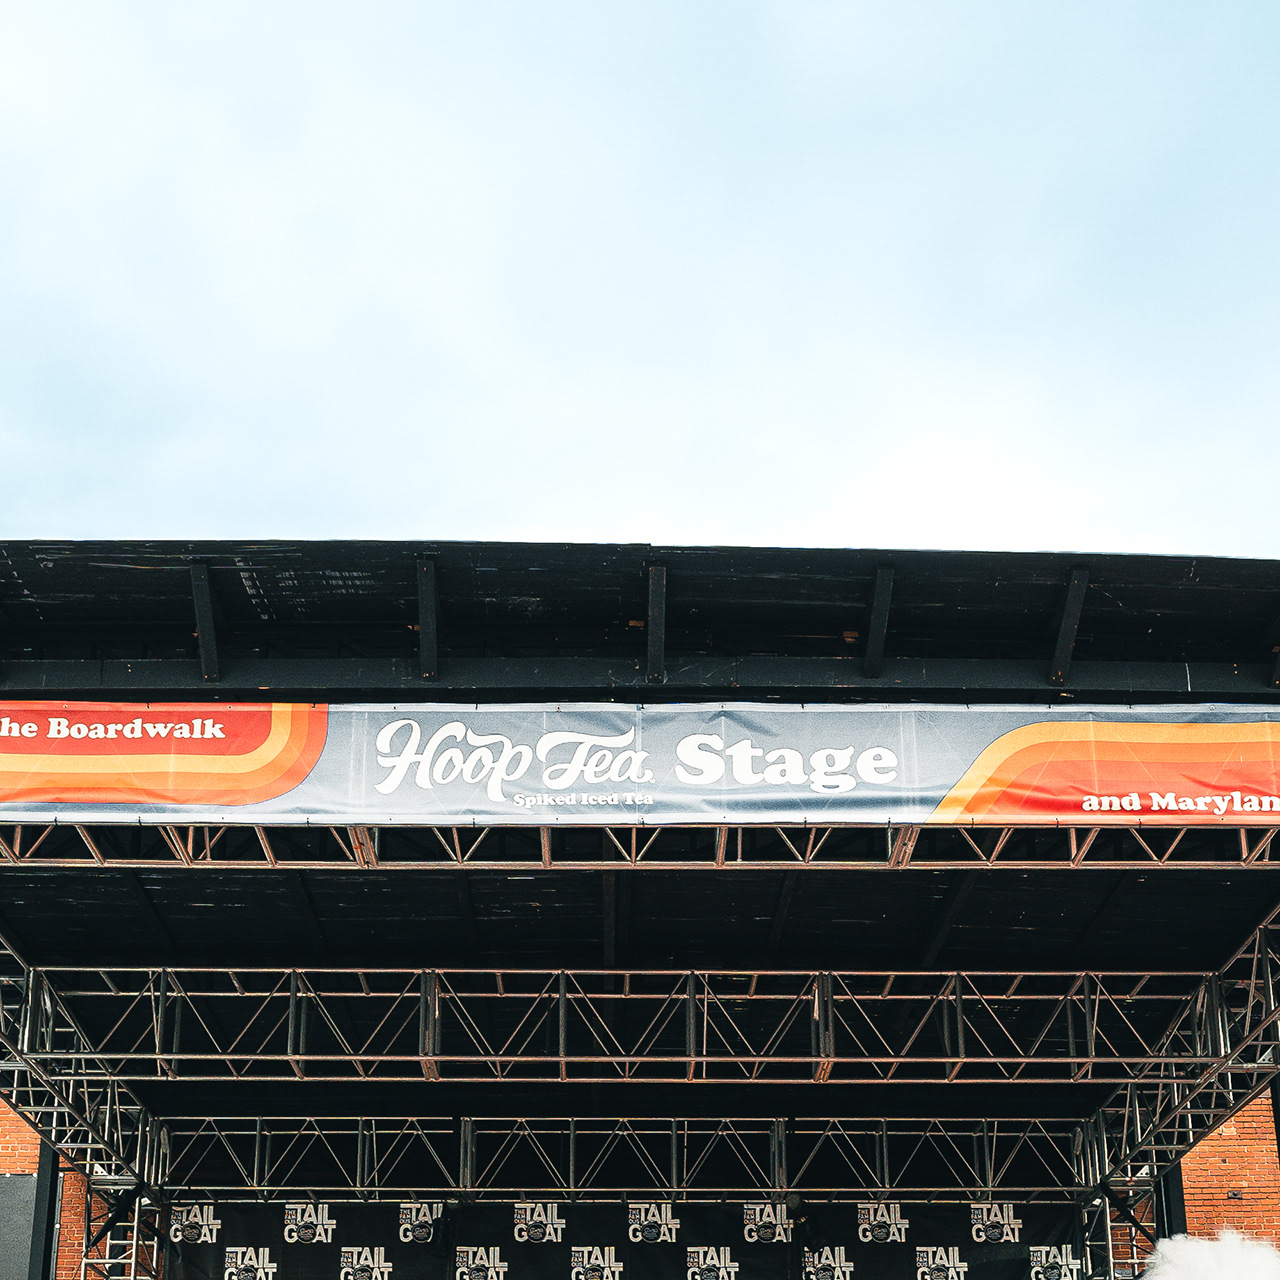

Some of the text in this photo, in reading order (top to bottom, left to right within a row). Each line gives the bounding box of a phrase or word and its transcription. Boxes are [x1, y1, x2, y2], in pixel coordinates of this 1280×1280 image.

[46, 718, 226, 740] Boardwalk
[374, 718, 533, 802] Hoop
[675, 733, 898, 794] Stage
[513, 791, 654, 809] Spiked Iced Tea
[1081, 791, 1141, 812] and
[171, 1205, 221, 1224] TAIL
[285, 1204, 336, 1223] TAIL
[515, 1204, 565, 1223] TAIL
[630, 1204, 680, 1223] TAIL
[859, 1204, 909, 1223] TAIL
[972, 1204, 1022, 1223] TAIL
[226, 1247, 277, 1267] TAIL
[341, 1247, 392, 1267] TAIL
[457, 1247, 507, 1267] TAIL
[572, 1247, 623, 1266] TAIL
[688, 1247, 739, 1267] TAIL
[917, 1247, 968, 1267] TAIL
[1031, 1245, 1081, 1265] TAIL
